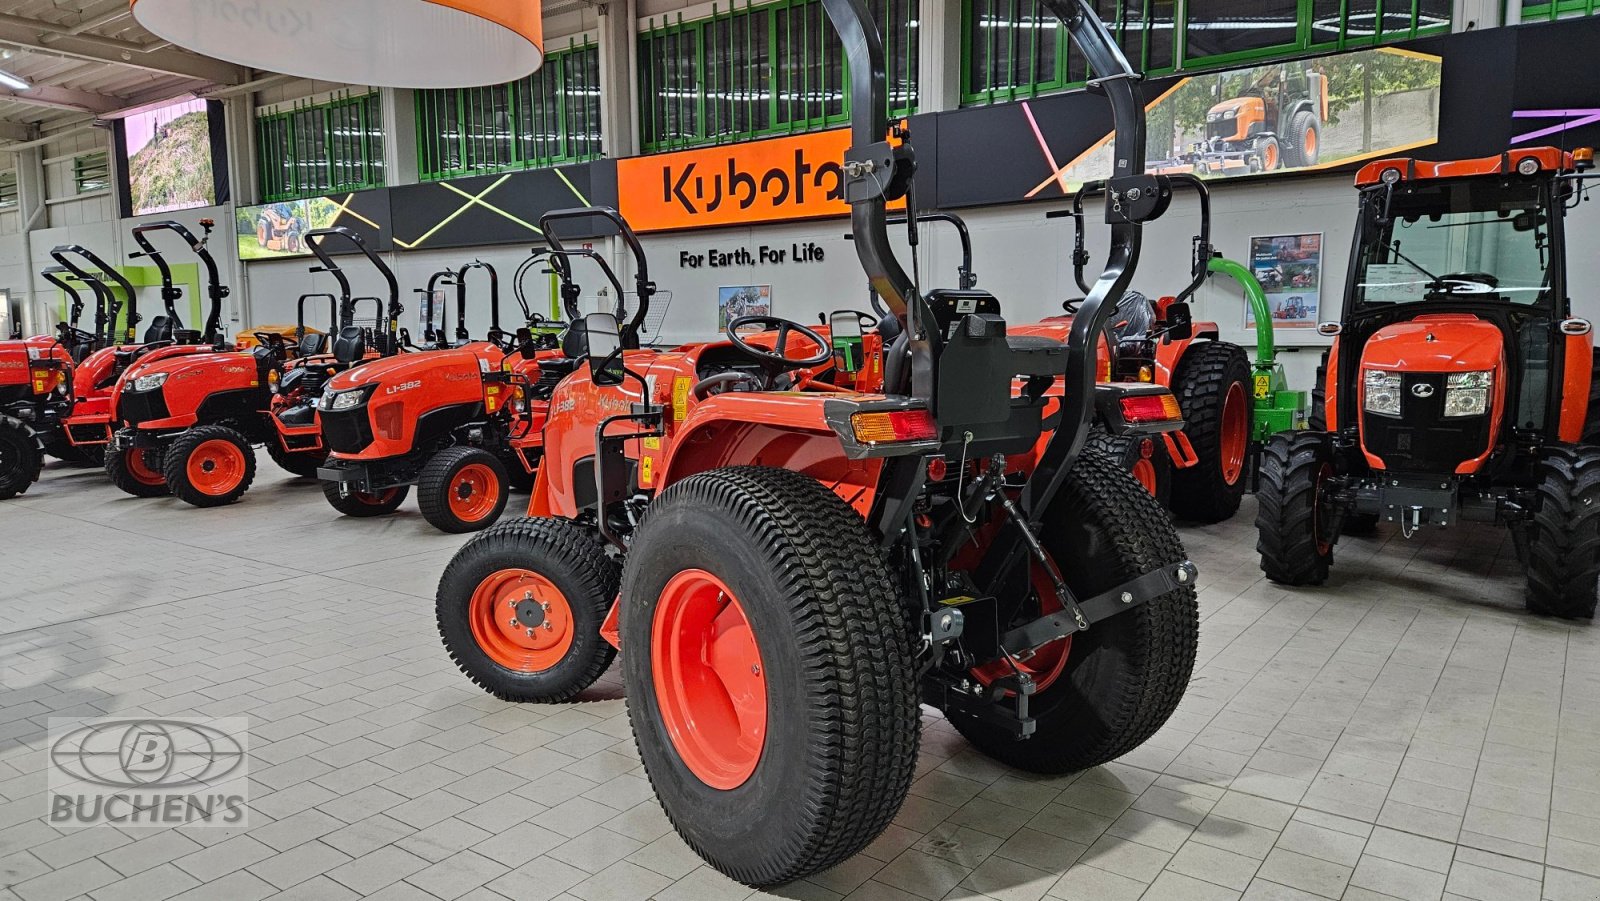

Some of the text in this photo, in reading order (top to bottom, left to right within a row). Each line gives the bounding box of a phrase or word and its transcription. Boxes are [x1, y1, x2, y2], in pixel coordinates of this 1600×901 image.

[663, 149, 845, 214] Kubota
[680, 242, 824, 268] For Earth, For Life
[386, 380, 421, 395] L1-382
